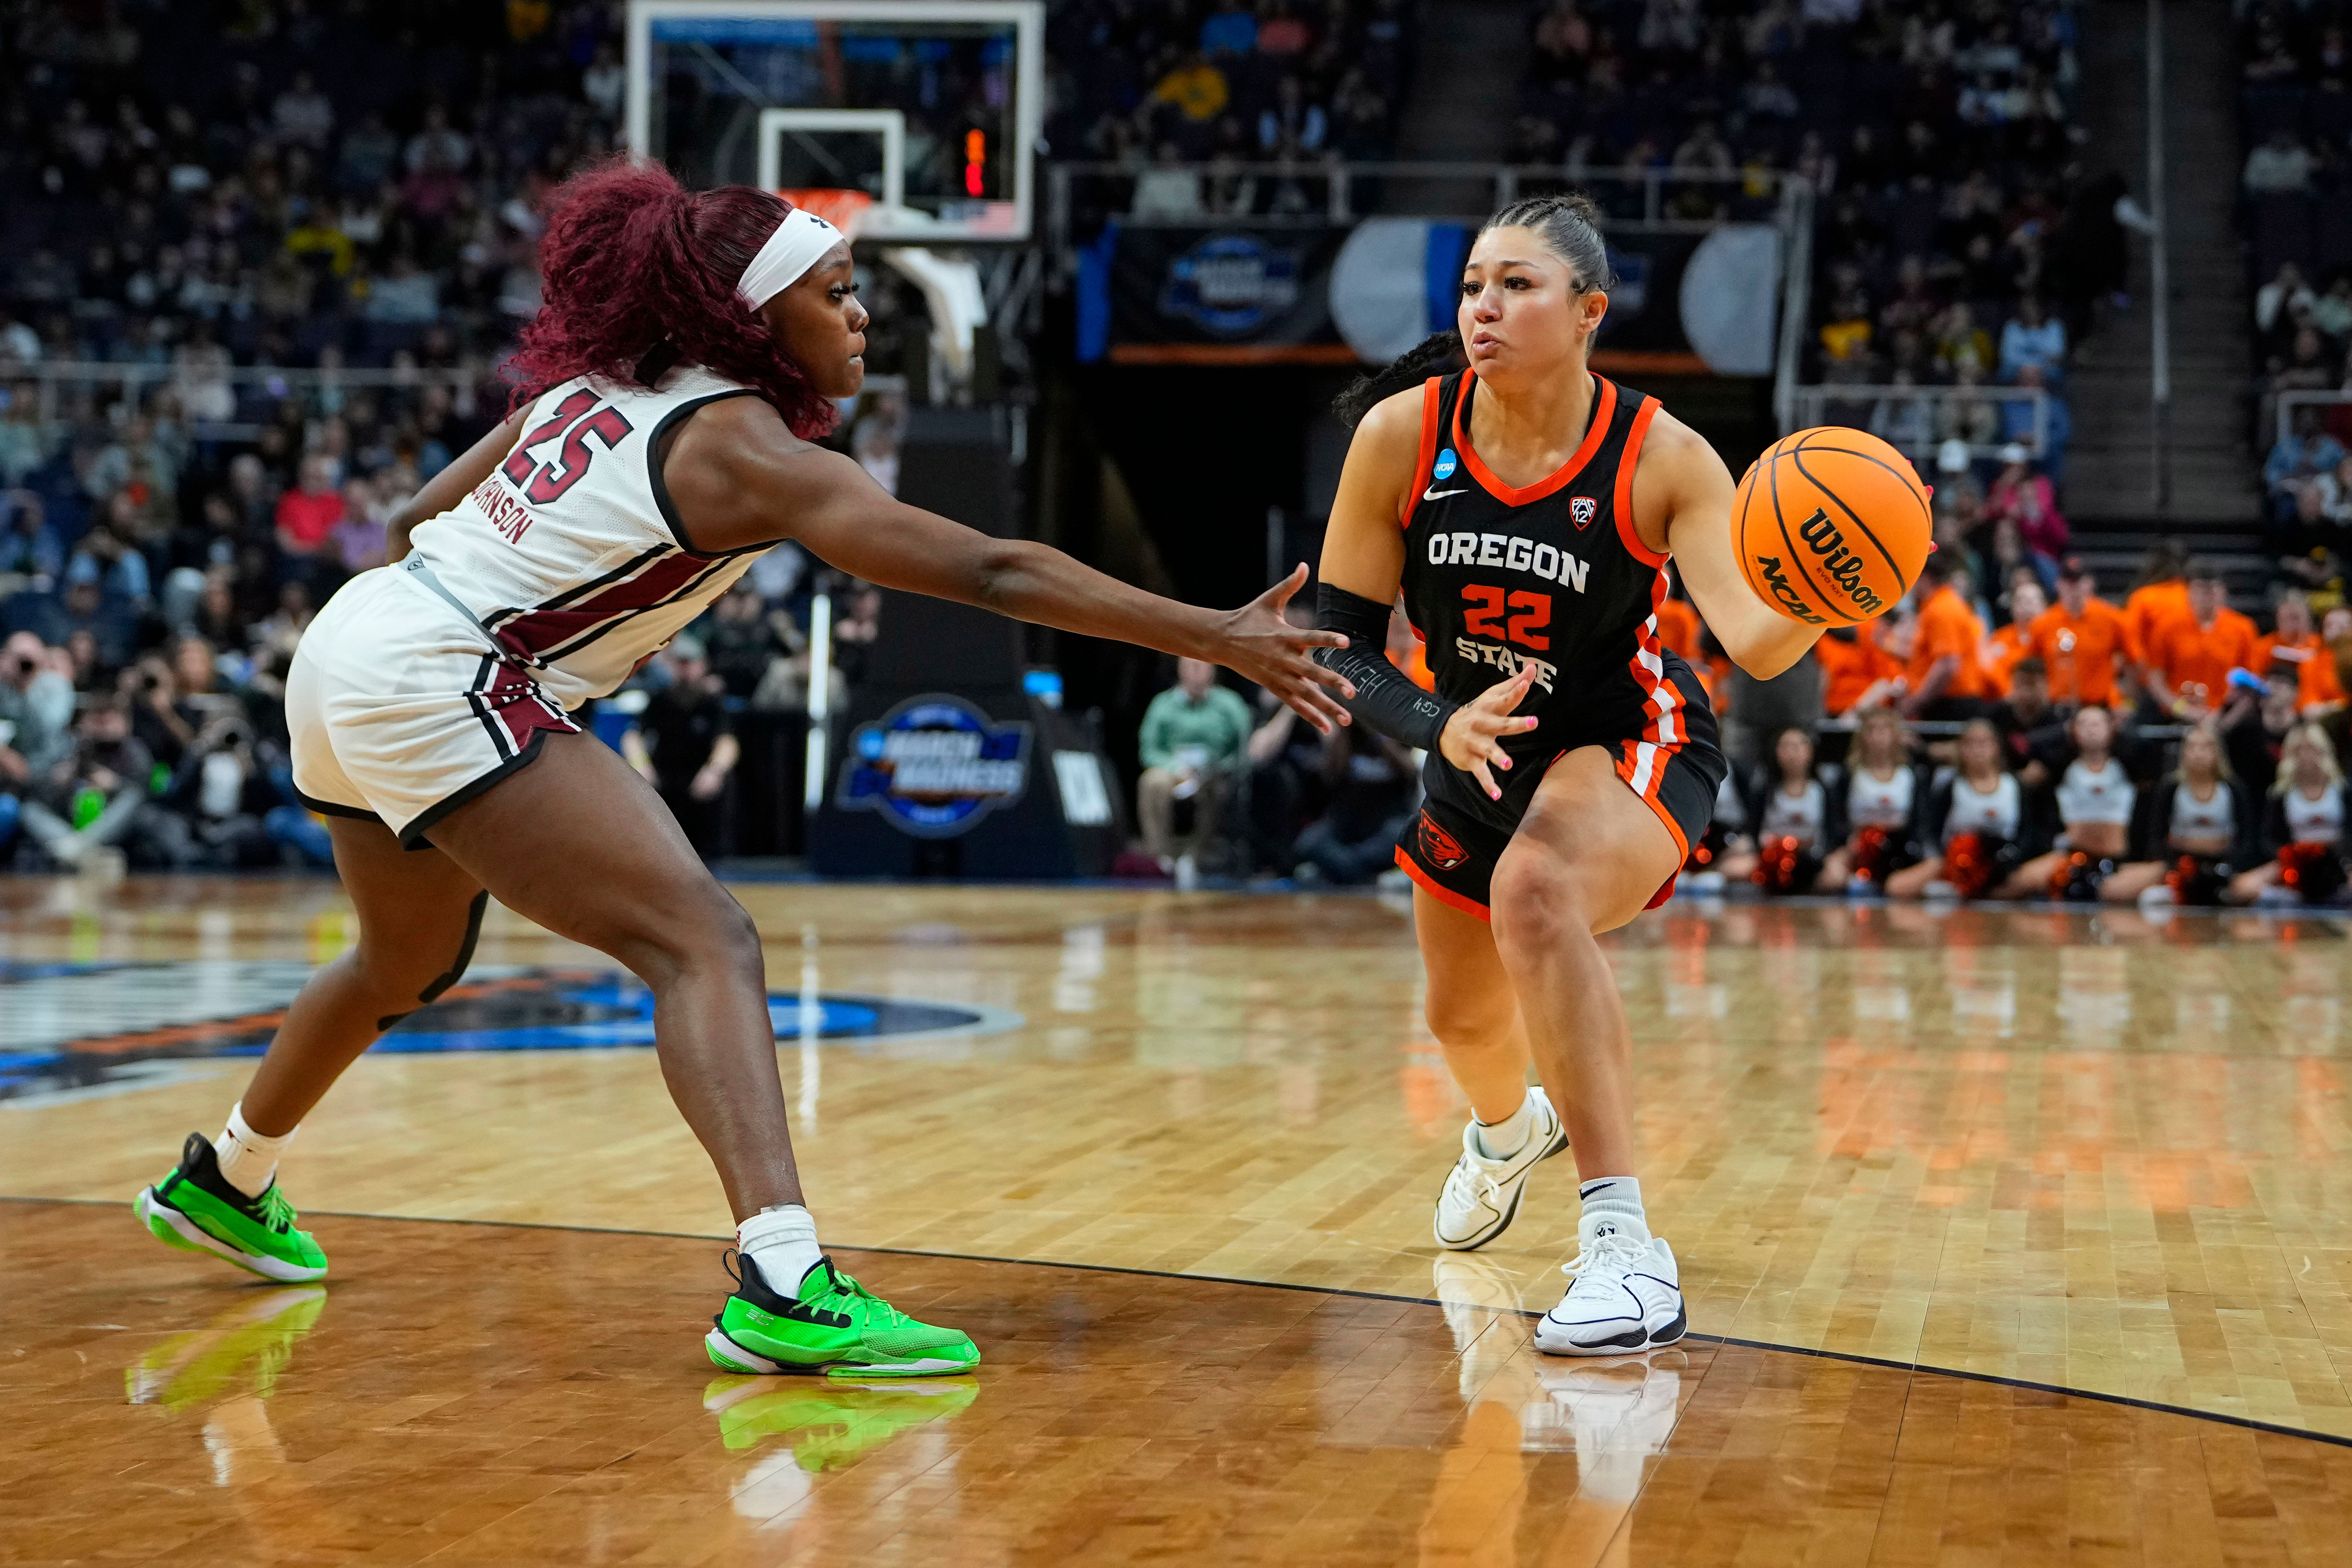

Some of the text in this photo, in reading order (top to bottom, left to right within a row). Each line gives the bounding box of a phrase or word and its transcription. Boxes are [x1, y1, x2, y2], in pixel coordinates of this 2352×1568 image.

[501, 387, 634, 505] 25
[1435, 463, 1454, 472] NCAA
[471, 475, 533, 545] JOHNSON
[1572, 498, 1596, 517] PAC
[1575, 510, 1588, 523] 12
[1428, 532, 1590, 594] OREGON
[1757, 555, 1829, 625] NCAA
[1799, 506, 1884, 614] Wilson
[1815, 567, 1831, 583] EVO
[1461, 583, 1552, 651] 22
[1456, 636, 1558, 695] STATE
